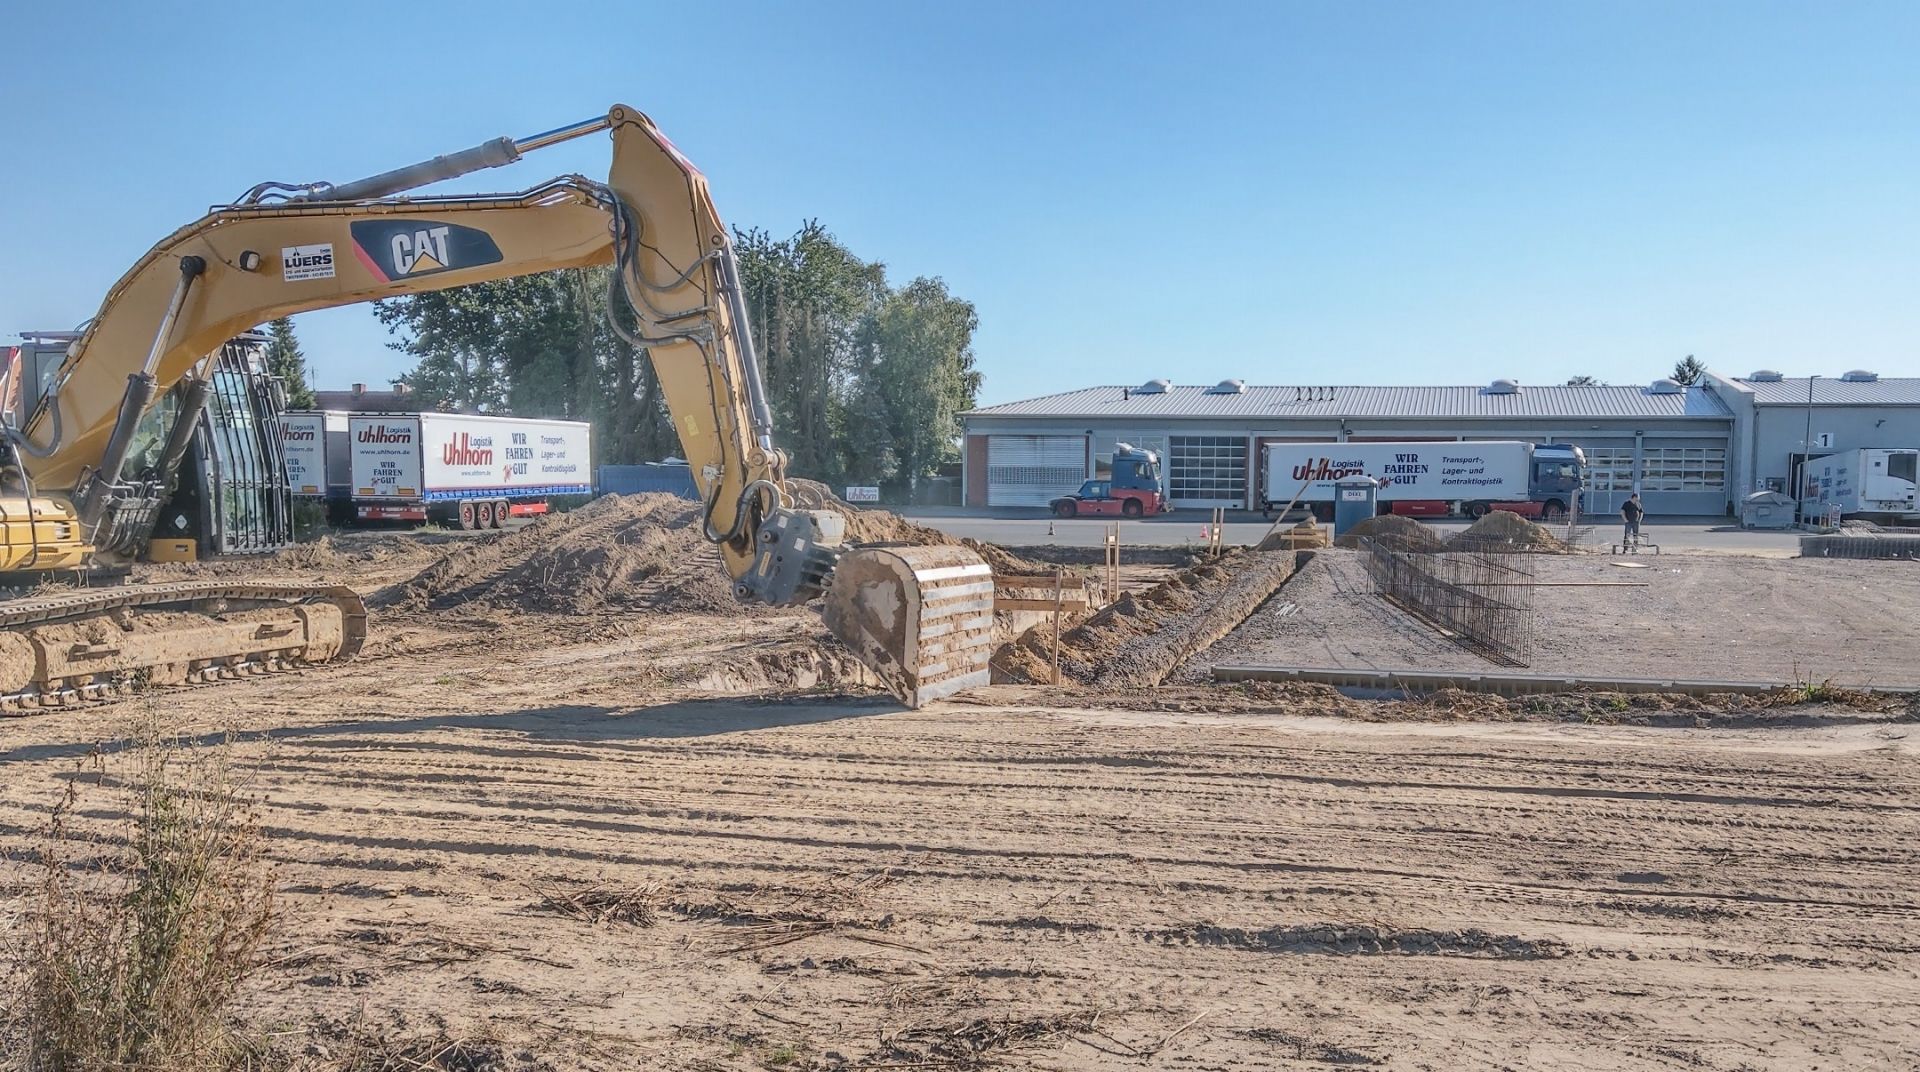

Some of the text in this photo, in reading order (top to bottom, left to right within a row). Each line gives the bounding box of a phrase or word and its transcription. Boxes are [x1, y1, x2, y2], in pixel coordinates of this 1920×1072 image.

[392, 227, 449, 275] CAT
[281, 422, 314, 441] lhorn
[358, 425, 411, 444] Uhlhorn
[386, 427, 411, 435] Logistik
[470, 436, 493, 449] Logistik
[511, 432, 527, 445] WIR
[1820, 434, 1829, 447] 1
[443, 432, 493, 466] Uhlhorn
[505, 447, 534, 460] FAHREN
[1331, 459, 1365, 470] Logistik
[1395, 453, 1419, 463] WIR
[373, 469, 403, 477] FAHREN
[512, 462, 528, 475] GUT
[1384, 464, 1429, 474] FAHREN
[1442, 467, 1467, 475] Lager-
[1394, 475, 1418, 484] GUT
[1441, 478, 1504, 486] Kontraktlogistik
